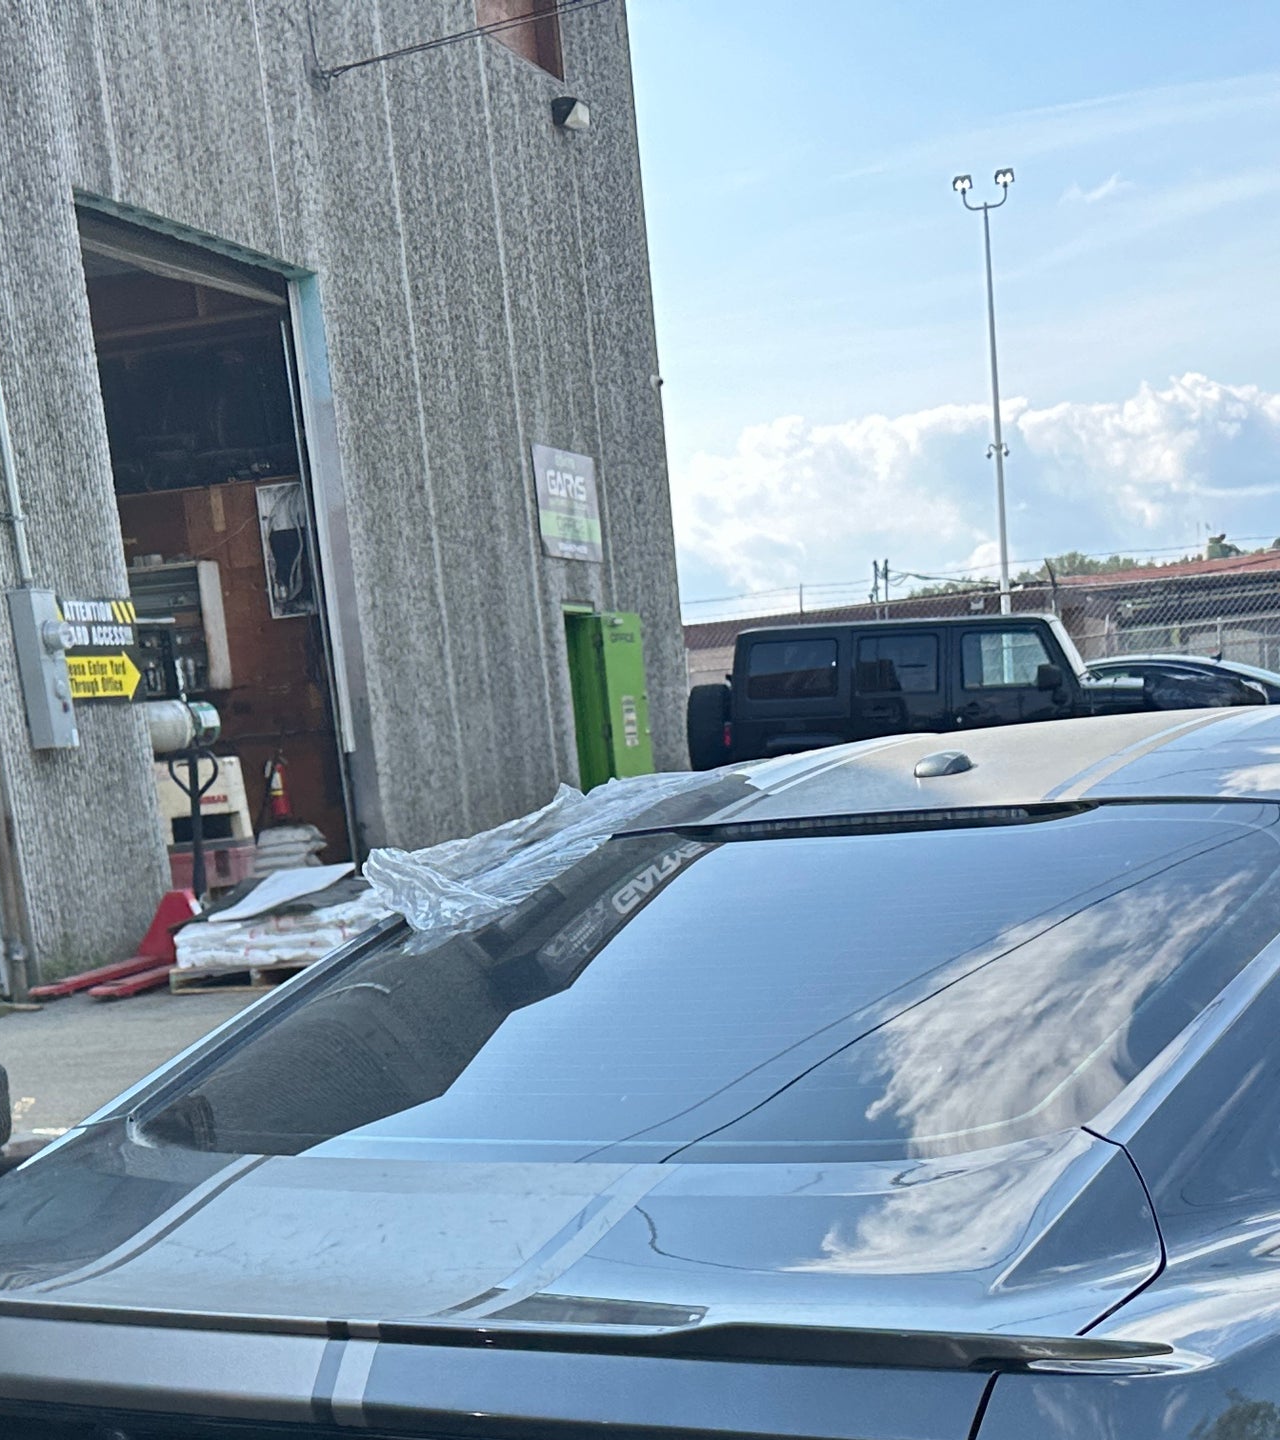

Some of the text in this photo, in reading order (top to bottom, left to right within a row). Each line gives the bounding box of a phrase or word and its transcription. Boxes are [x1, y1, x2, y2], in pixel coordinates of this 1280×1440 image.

[62, 601, 113, 622] ATTENTION
[87, 660, 107, 676] Enter
[109, 660, 126, 675] Yard
[70, 677, 123, 695] Through Office
